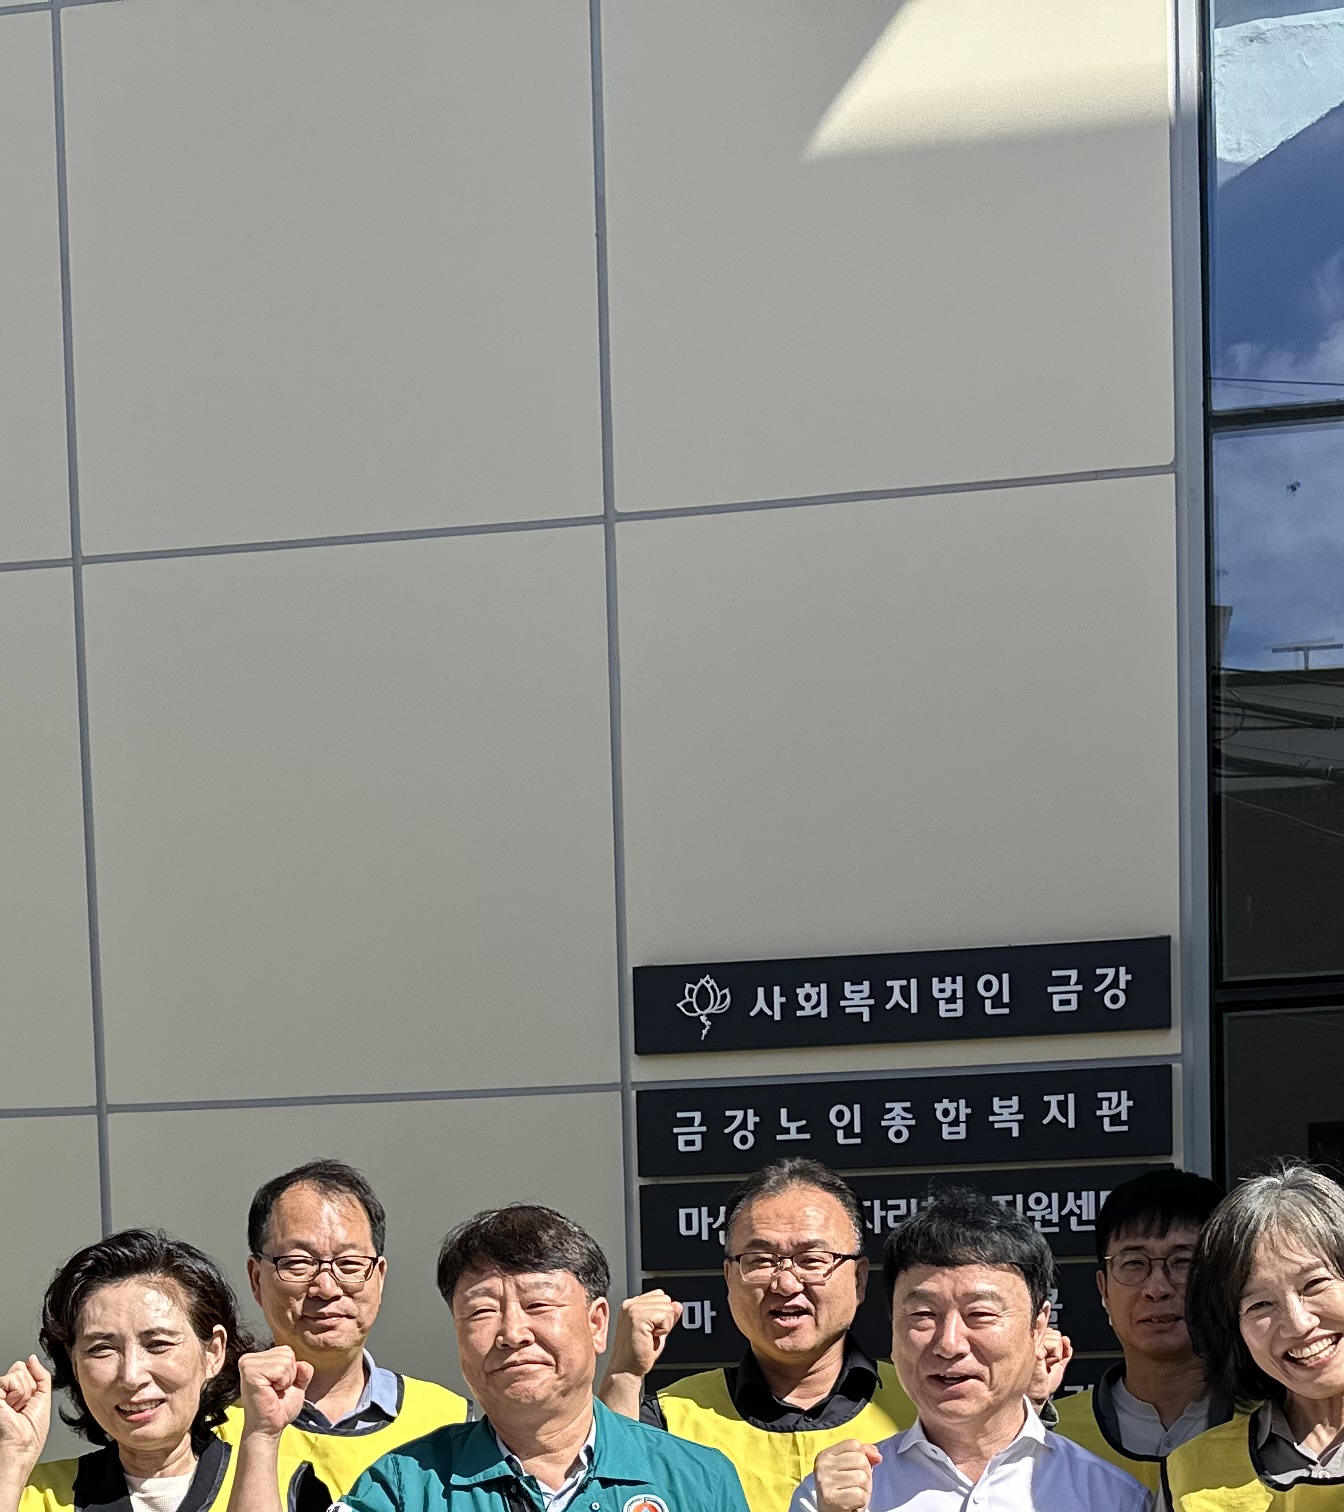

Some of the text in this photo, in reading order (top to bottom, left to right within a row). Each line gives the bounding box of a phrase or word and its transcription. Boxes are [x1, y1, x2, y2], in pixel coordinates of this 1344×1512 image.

[749, 966, 1133, 1022] 사회복지법인 금강
[672, 1089, 1134, 1153] 금강노인종합복지관
